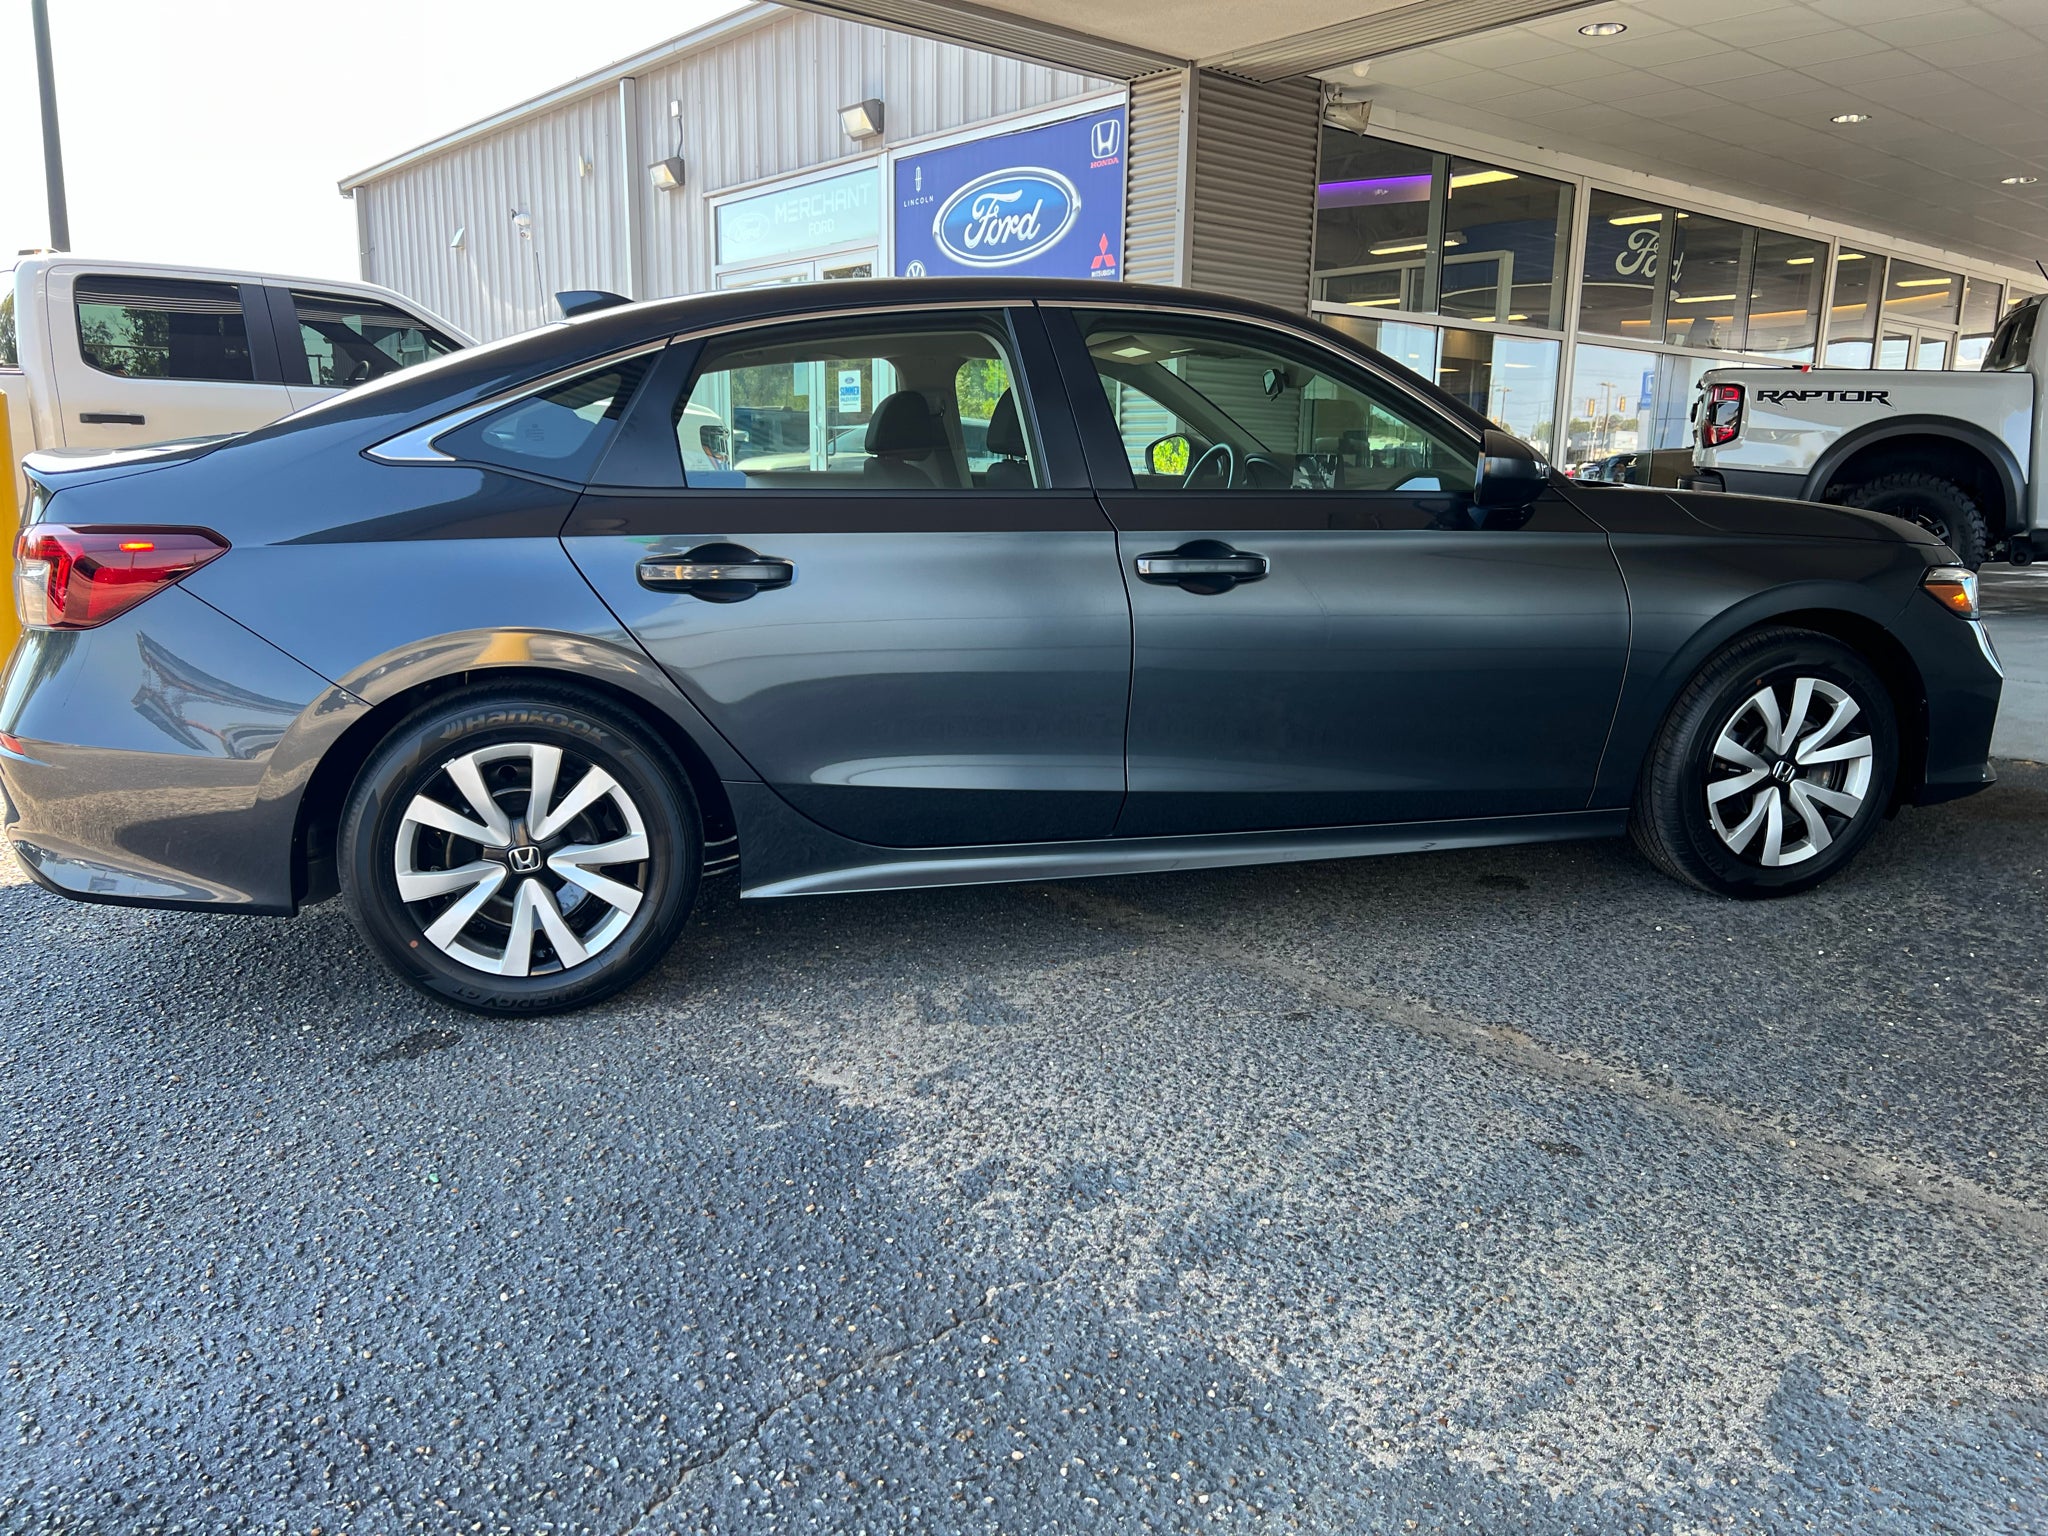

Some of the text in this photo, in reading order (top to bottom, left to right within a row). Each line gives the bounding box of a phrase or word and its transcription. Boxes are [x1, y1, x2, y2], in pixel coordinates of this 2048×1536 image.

[1090, 157, 1119, 169] HONDA
[774, 182, 872, 225] MERCHANT
[903, 194, 934, 208] LINCOLN
[808, 218, 835, 237] FORD
[963, 189, 1044, 249] Ford
[1615, 228, 1684, 284] Fod
[1756, 389, 1896, 410] RAPTOR
